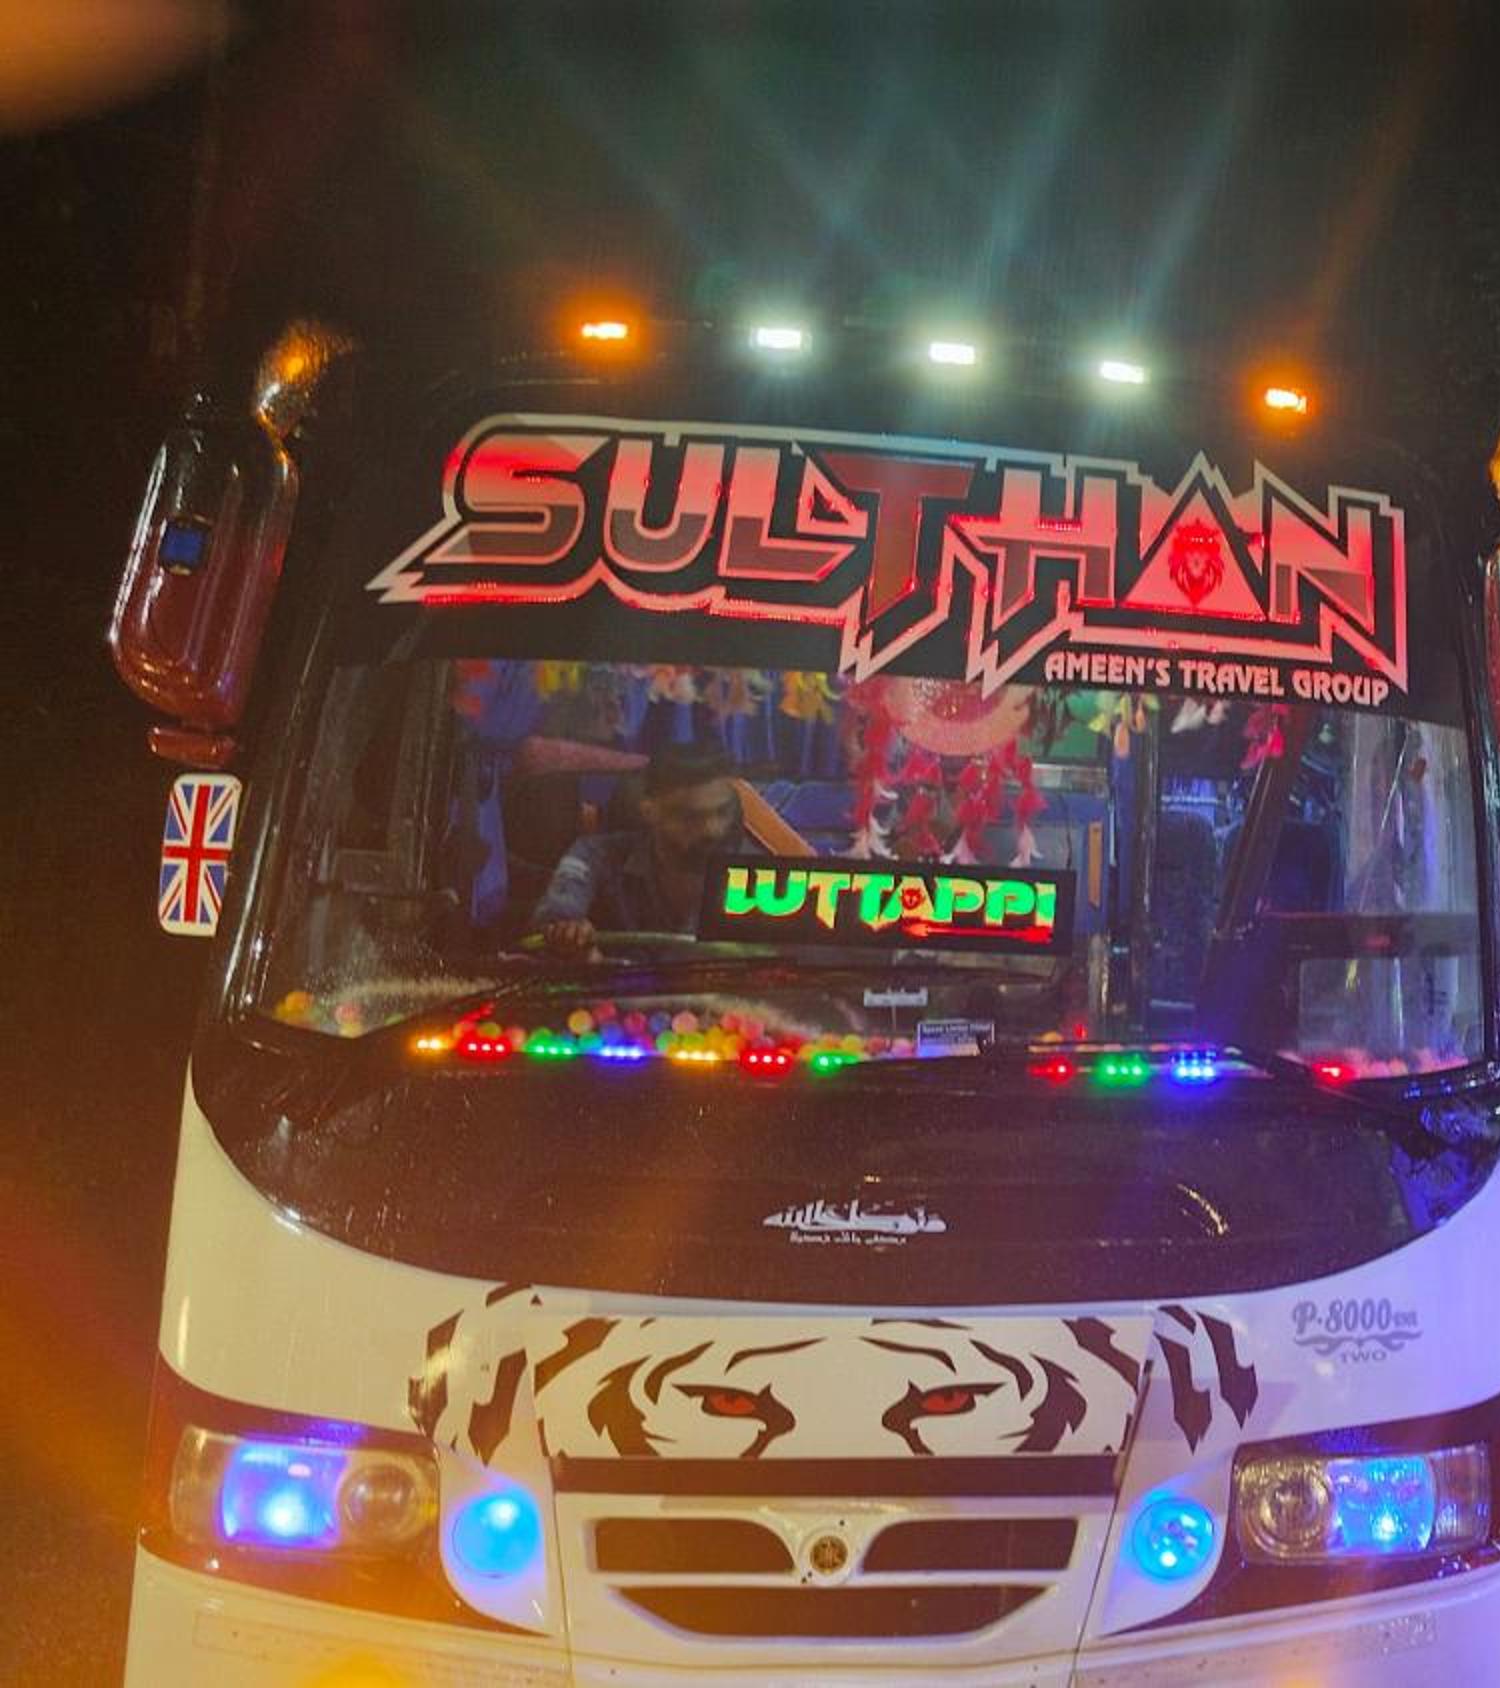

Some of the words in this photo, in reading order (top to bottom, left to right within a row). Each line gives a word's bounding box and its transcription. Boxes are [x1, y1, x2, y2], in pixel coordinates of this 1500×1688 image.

[368, 414, 1408, 692] SULTHAN
[1044, 650, 1172, 688] AMEEN'S
[1179, 658, 1285, 696] TRAVEL
[1291, 668, 1390, 707] GROUP
